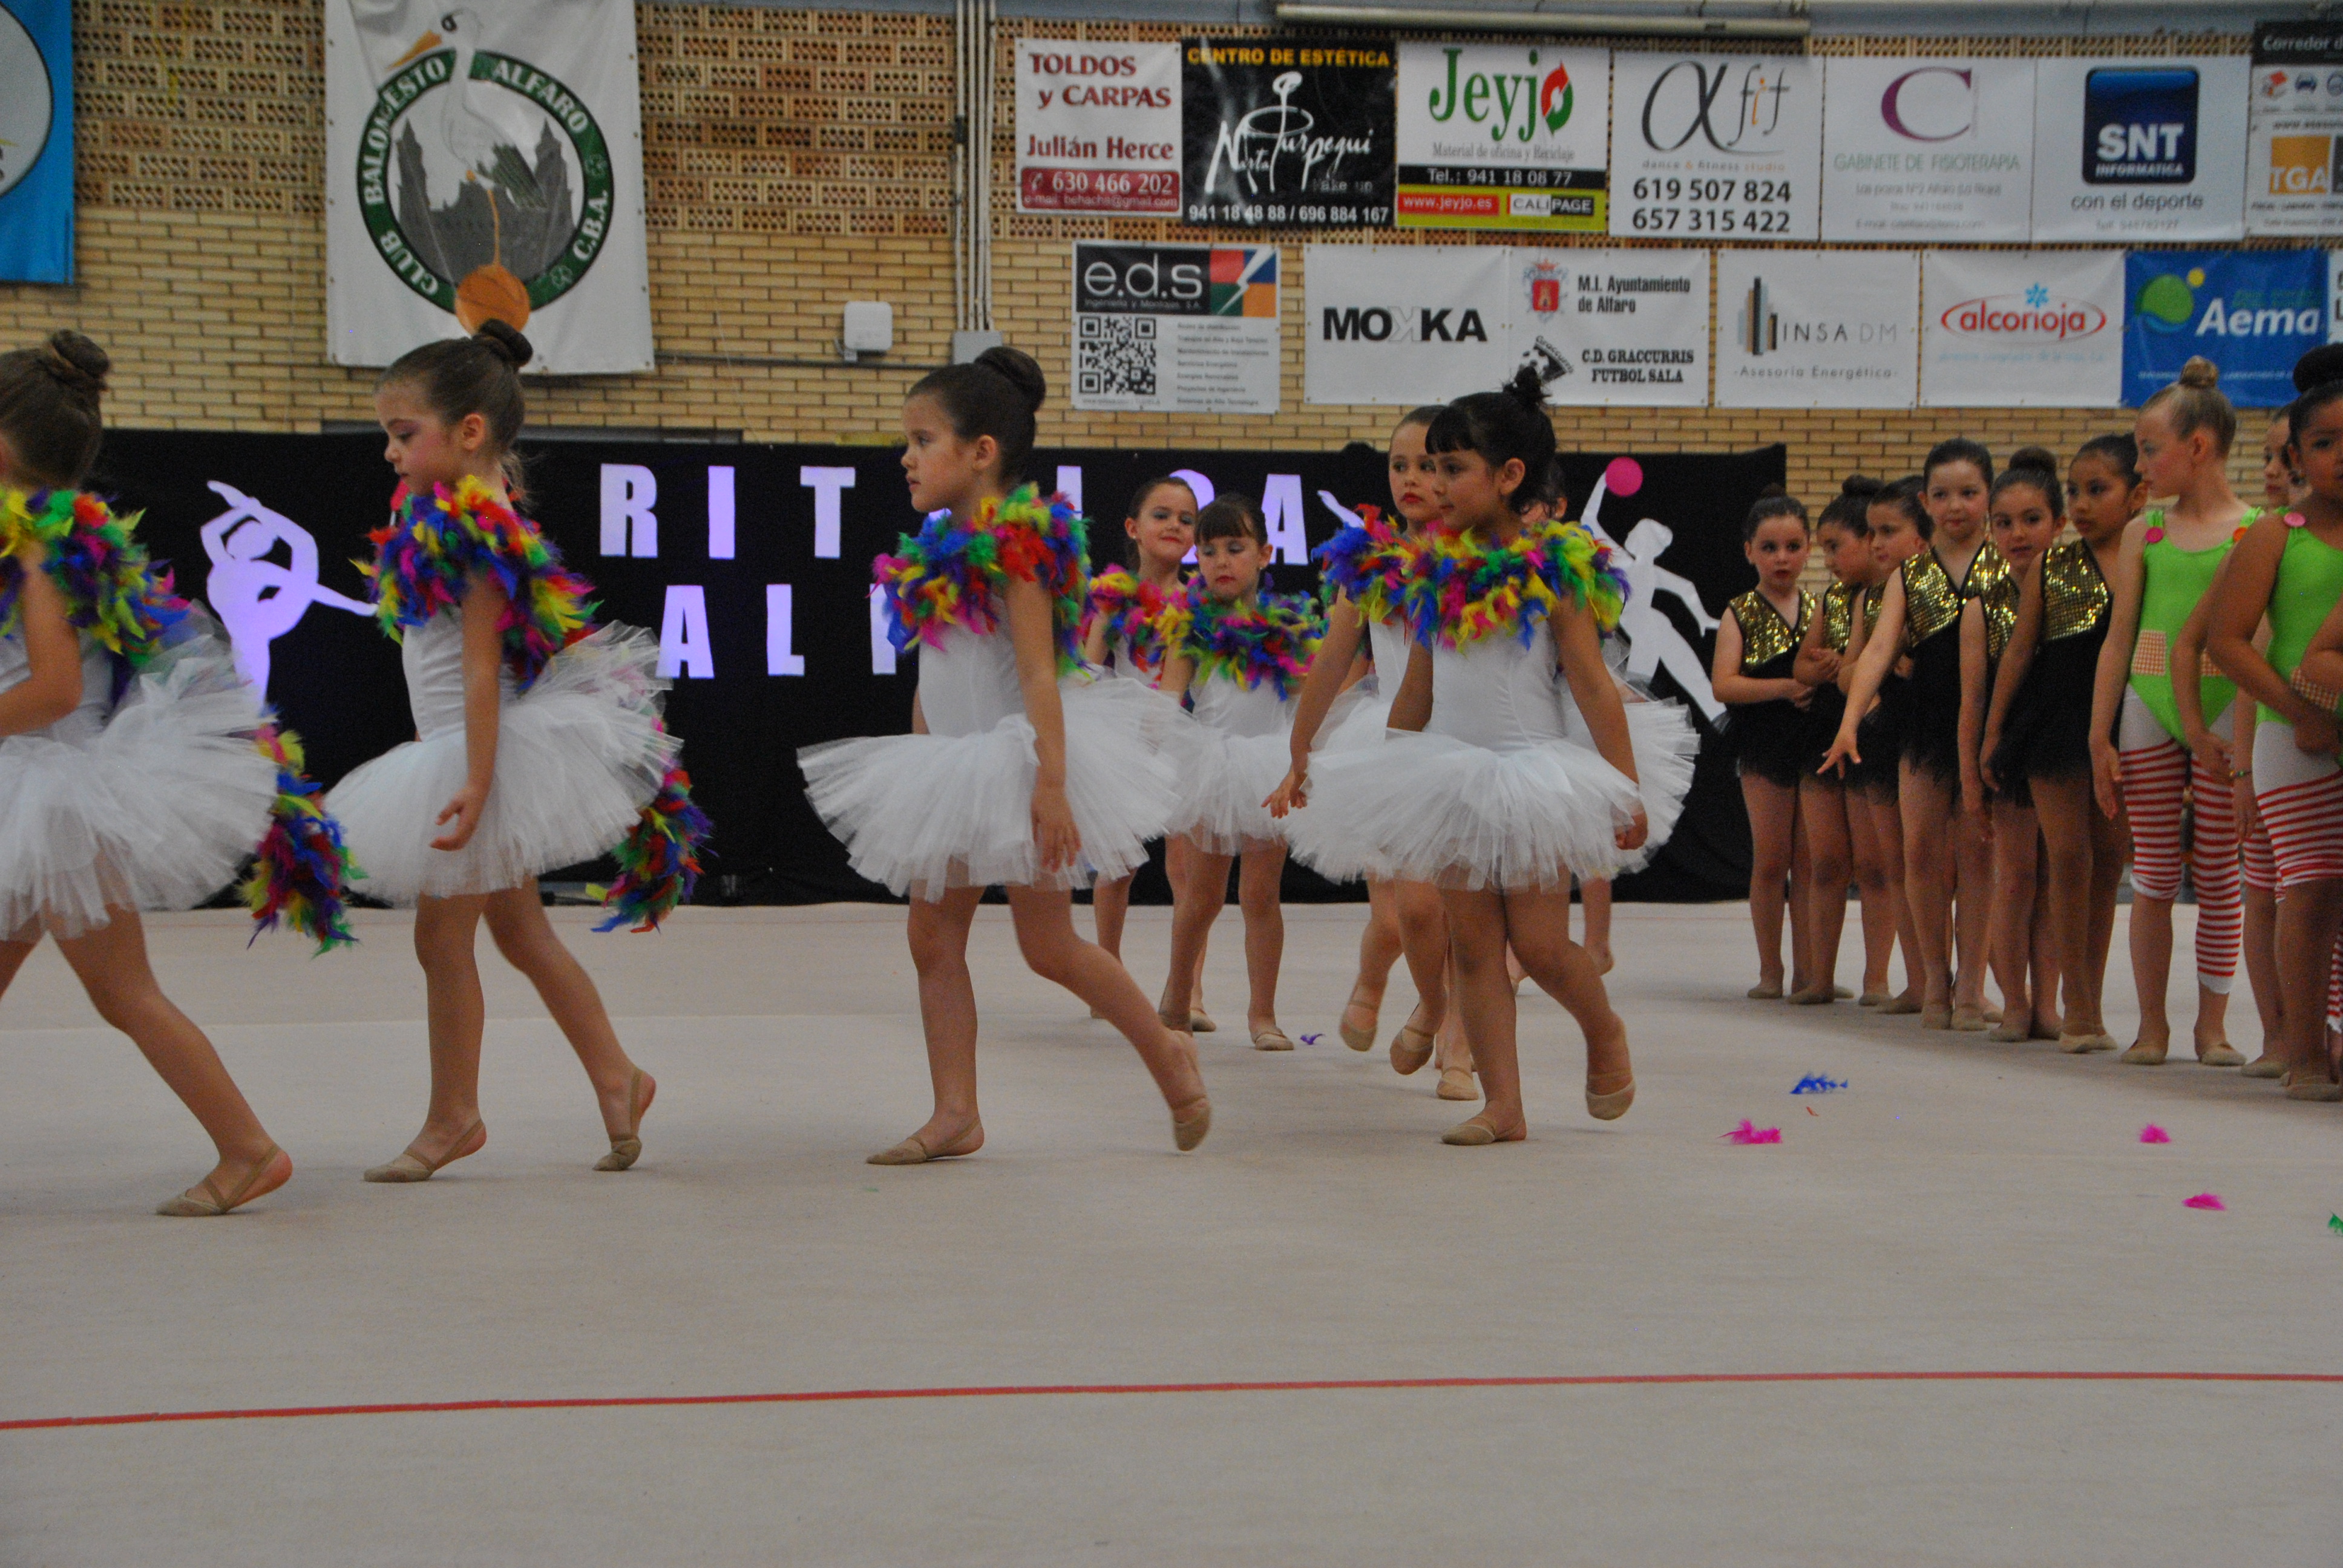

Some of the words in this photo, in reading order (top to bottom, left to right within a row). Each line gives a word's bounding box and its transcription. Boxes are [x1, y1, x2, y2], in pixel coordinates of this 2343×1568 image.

[1029, 53, 1136, 76] TOLDOS
[1187, 48, 1265, 65] CENTRO
[1271, 48, 1294, 65] DE
[1300, 48, 1390, 67] ESTÉTICA
[1038, 90, 1053, 110] y
[1062, 85, 1172, 108] CARPAS
[1027, 135, 1097, 158] Julián
[1107, 136, 1174, 160] Herce
[2097, 123, 2185, 162] SNT
[1906, 154, 1924, 172] DE
[380, 230, 439, 296] CLUB
[492, 60, 589, 134] ALFARO
[572, 189, 609, 261] C.B.A.
[1052, 171, 1089, 192] 630
[1095, 172, 1130, 194] 466
[1138, 174, 1173, 195] 202
[1467, 169, 1496, 184] 941
[1504, 169, 1522, 185] 18
[1527, 171, 1547, 185] 08
[1554, 172, 1573, 186] 77
[2270, 166, 2330, 191] TGA
[1633, 177, 1681, 200] 619
[1689, 178, 1736, 201] 507
[1743, 178, 1791, 203] 824
[1403, 197, 1492, 209] www.jeyjo.es
[2071, 195, 2104, 210] con
[2110, 192, 2126, 209] el
[2132, 192, 2204, 212] deporte
[1188, 206, 1215, 221] 941
[1223, 206, 1240, 221] 18
[1244, 206, 1263, 223] 48
[1299, 207, 1326, 221] 696
[1330, 207, 1358, 222] 884
[1363, 207, 1388, 223] 167
[1633, 208, 1680, 230] 657
[1688, 209, 1735, 232] 315
[1743, 209, 1790, 233] 422
[1084, 253, 1203, 299] e.d.s
[1578, 275, 1602, 292] M.I.
[1608, 276, 1691, 294] Ayuntamiento
[1578, 296, 1592, 312] de
[1598, 297, 1636, 312] Alfaro
[2195, 298, 2319, 337] Aema
[1783, 322, 1847, 342] INSA
[1860, 323, 1896, 343] DM
[1582, 349, 1604, 363] C.D.
[1608, 349, 1694, 364] GRACCURRIS
[1592, 368, 1645, 383] FUTBOL
[1649, 369, 1683, 383] SALA
